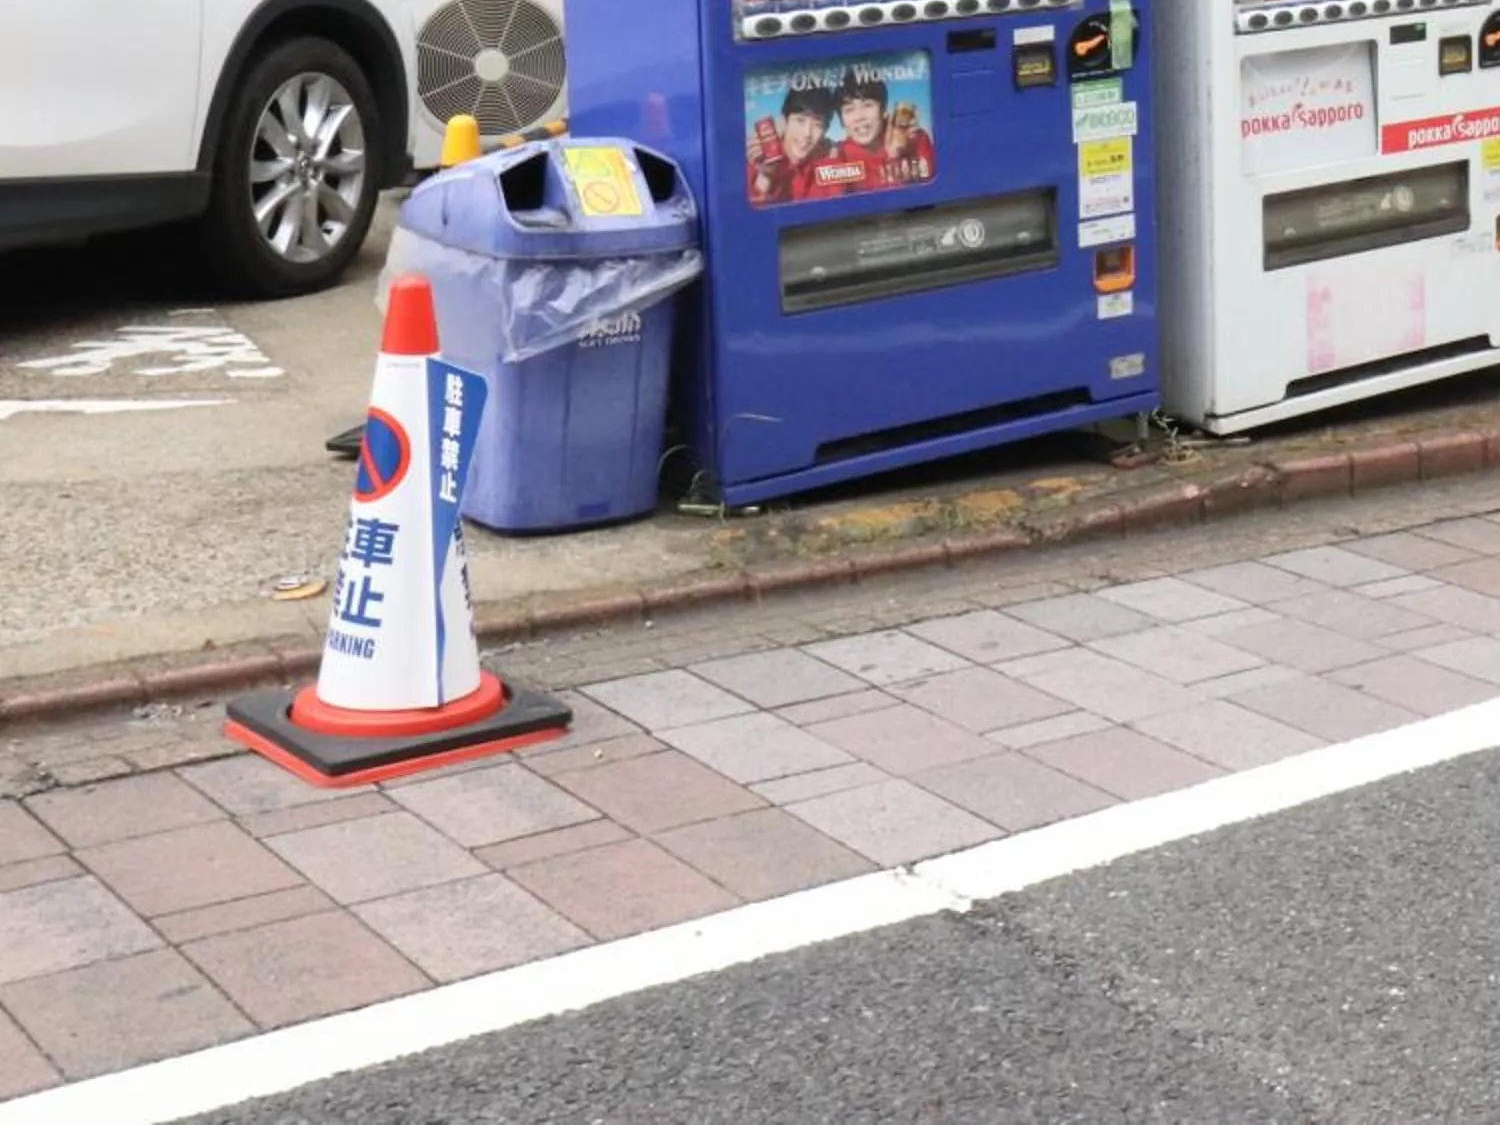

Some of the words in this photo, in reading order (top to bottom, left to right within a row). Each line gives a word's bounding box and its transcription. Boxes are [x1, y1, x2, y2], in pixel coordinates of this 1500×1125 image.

[439, 372, 464, 504] 駐車禁止
[340, 518, 399, 568] 車
